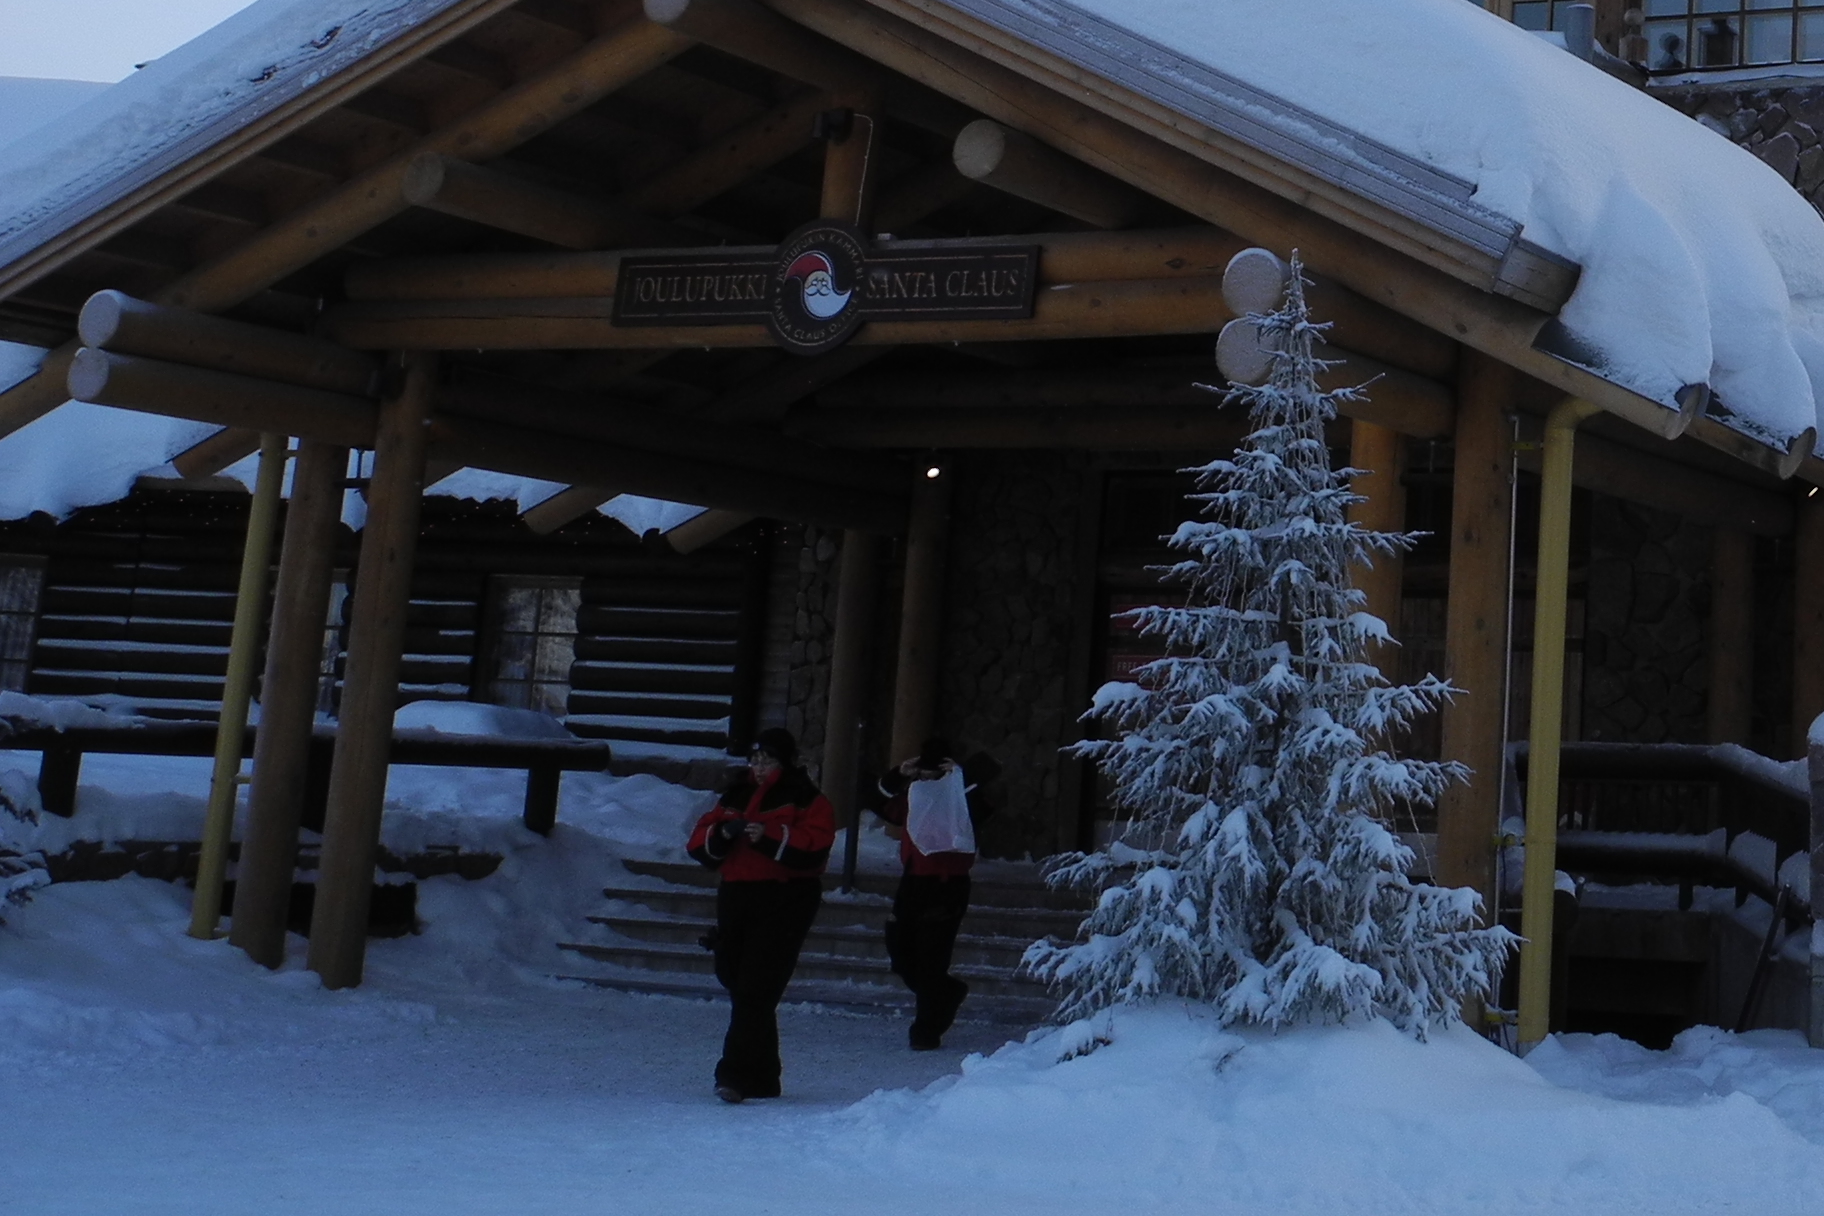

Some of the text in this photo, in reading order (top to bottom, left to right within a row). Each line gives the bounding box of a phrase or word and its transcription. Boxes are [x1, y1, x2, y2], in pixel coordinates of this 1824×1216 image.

[633, 273, 767, 307] JOULUPUKKI
[866, 268, 1019, 299] SANTA CLAUS
